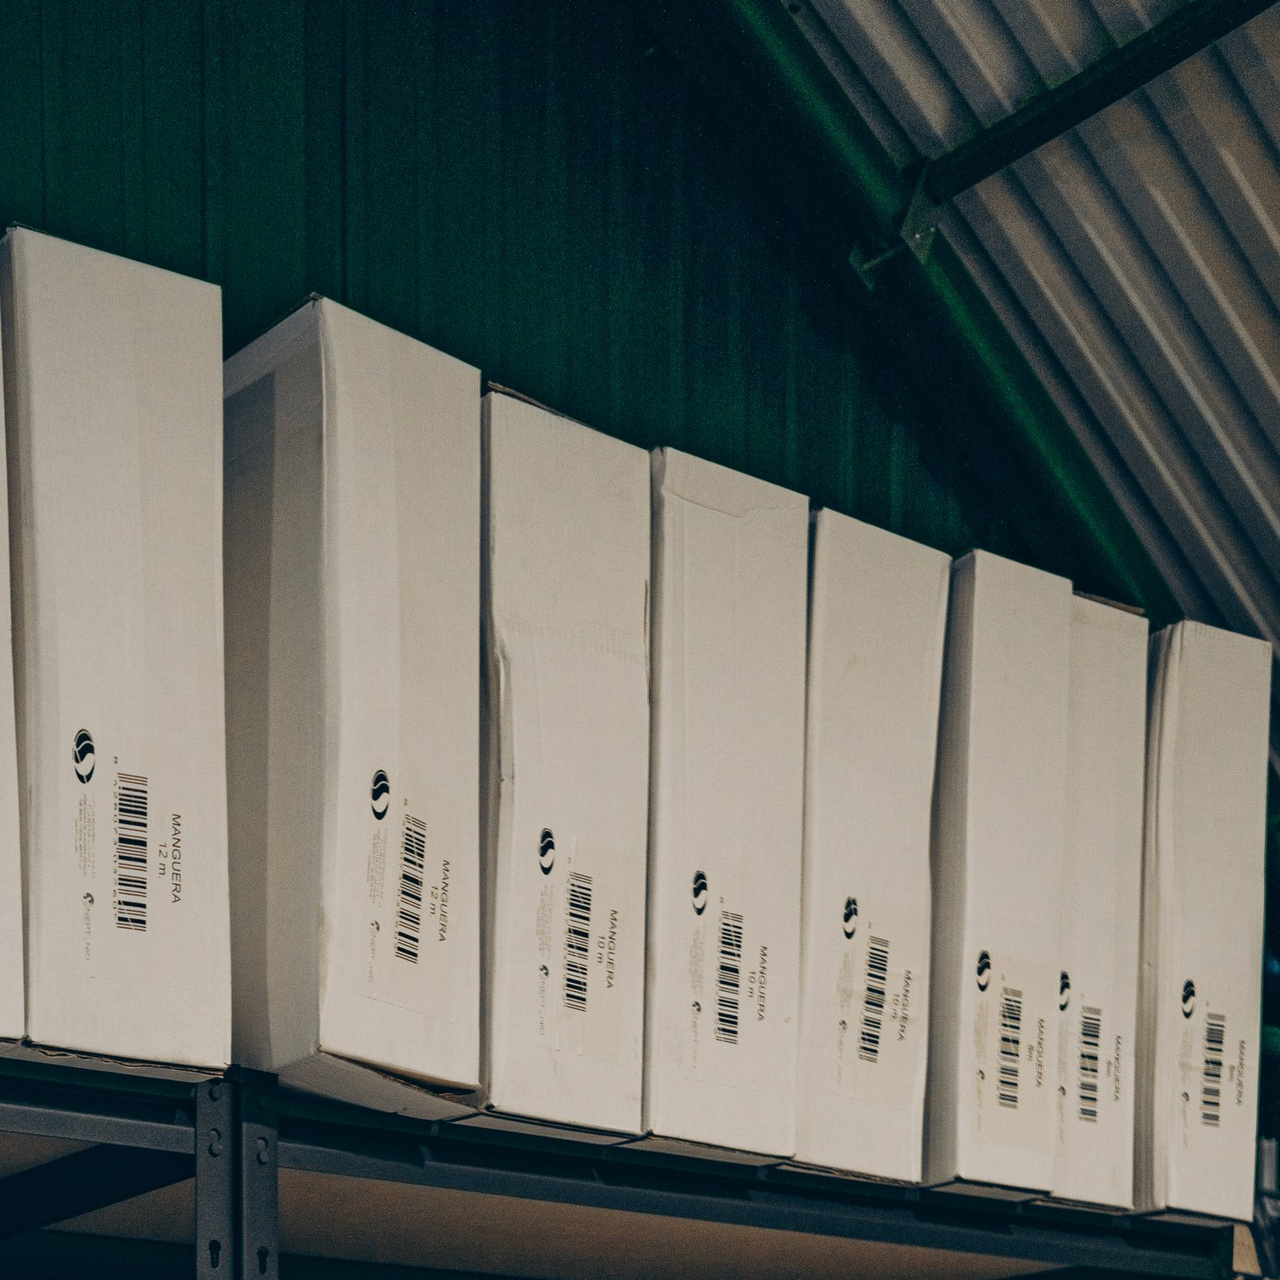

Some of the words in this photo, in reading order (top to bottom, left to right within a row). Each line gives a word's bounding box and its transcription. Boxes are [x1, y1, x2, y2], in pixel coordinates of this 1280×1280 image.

[158, 842, 168, 858] 12
[171, 813, 182, 904] MANGUERA
[430, 884, 438, 900] 12
[438, 859, 450, 942] MANGUERA
[606, 909, 618, 989] MANGUERA
[757, 945, 768, 1021] MANGUERA
